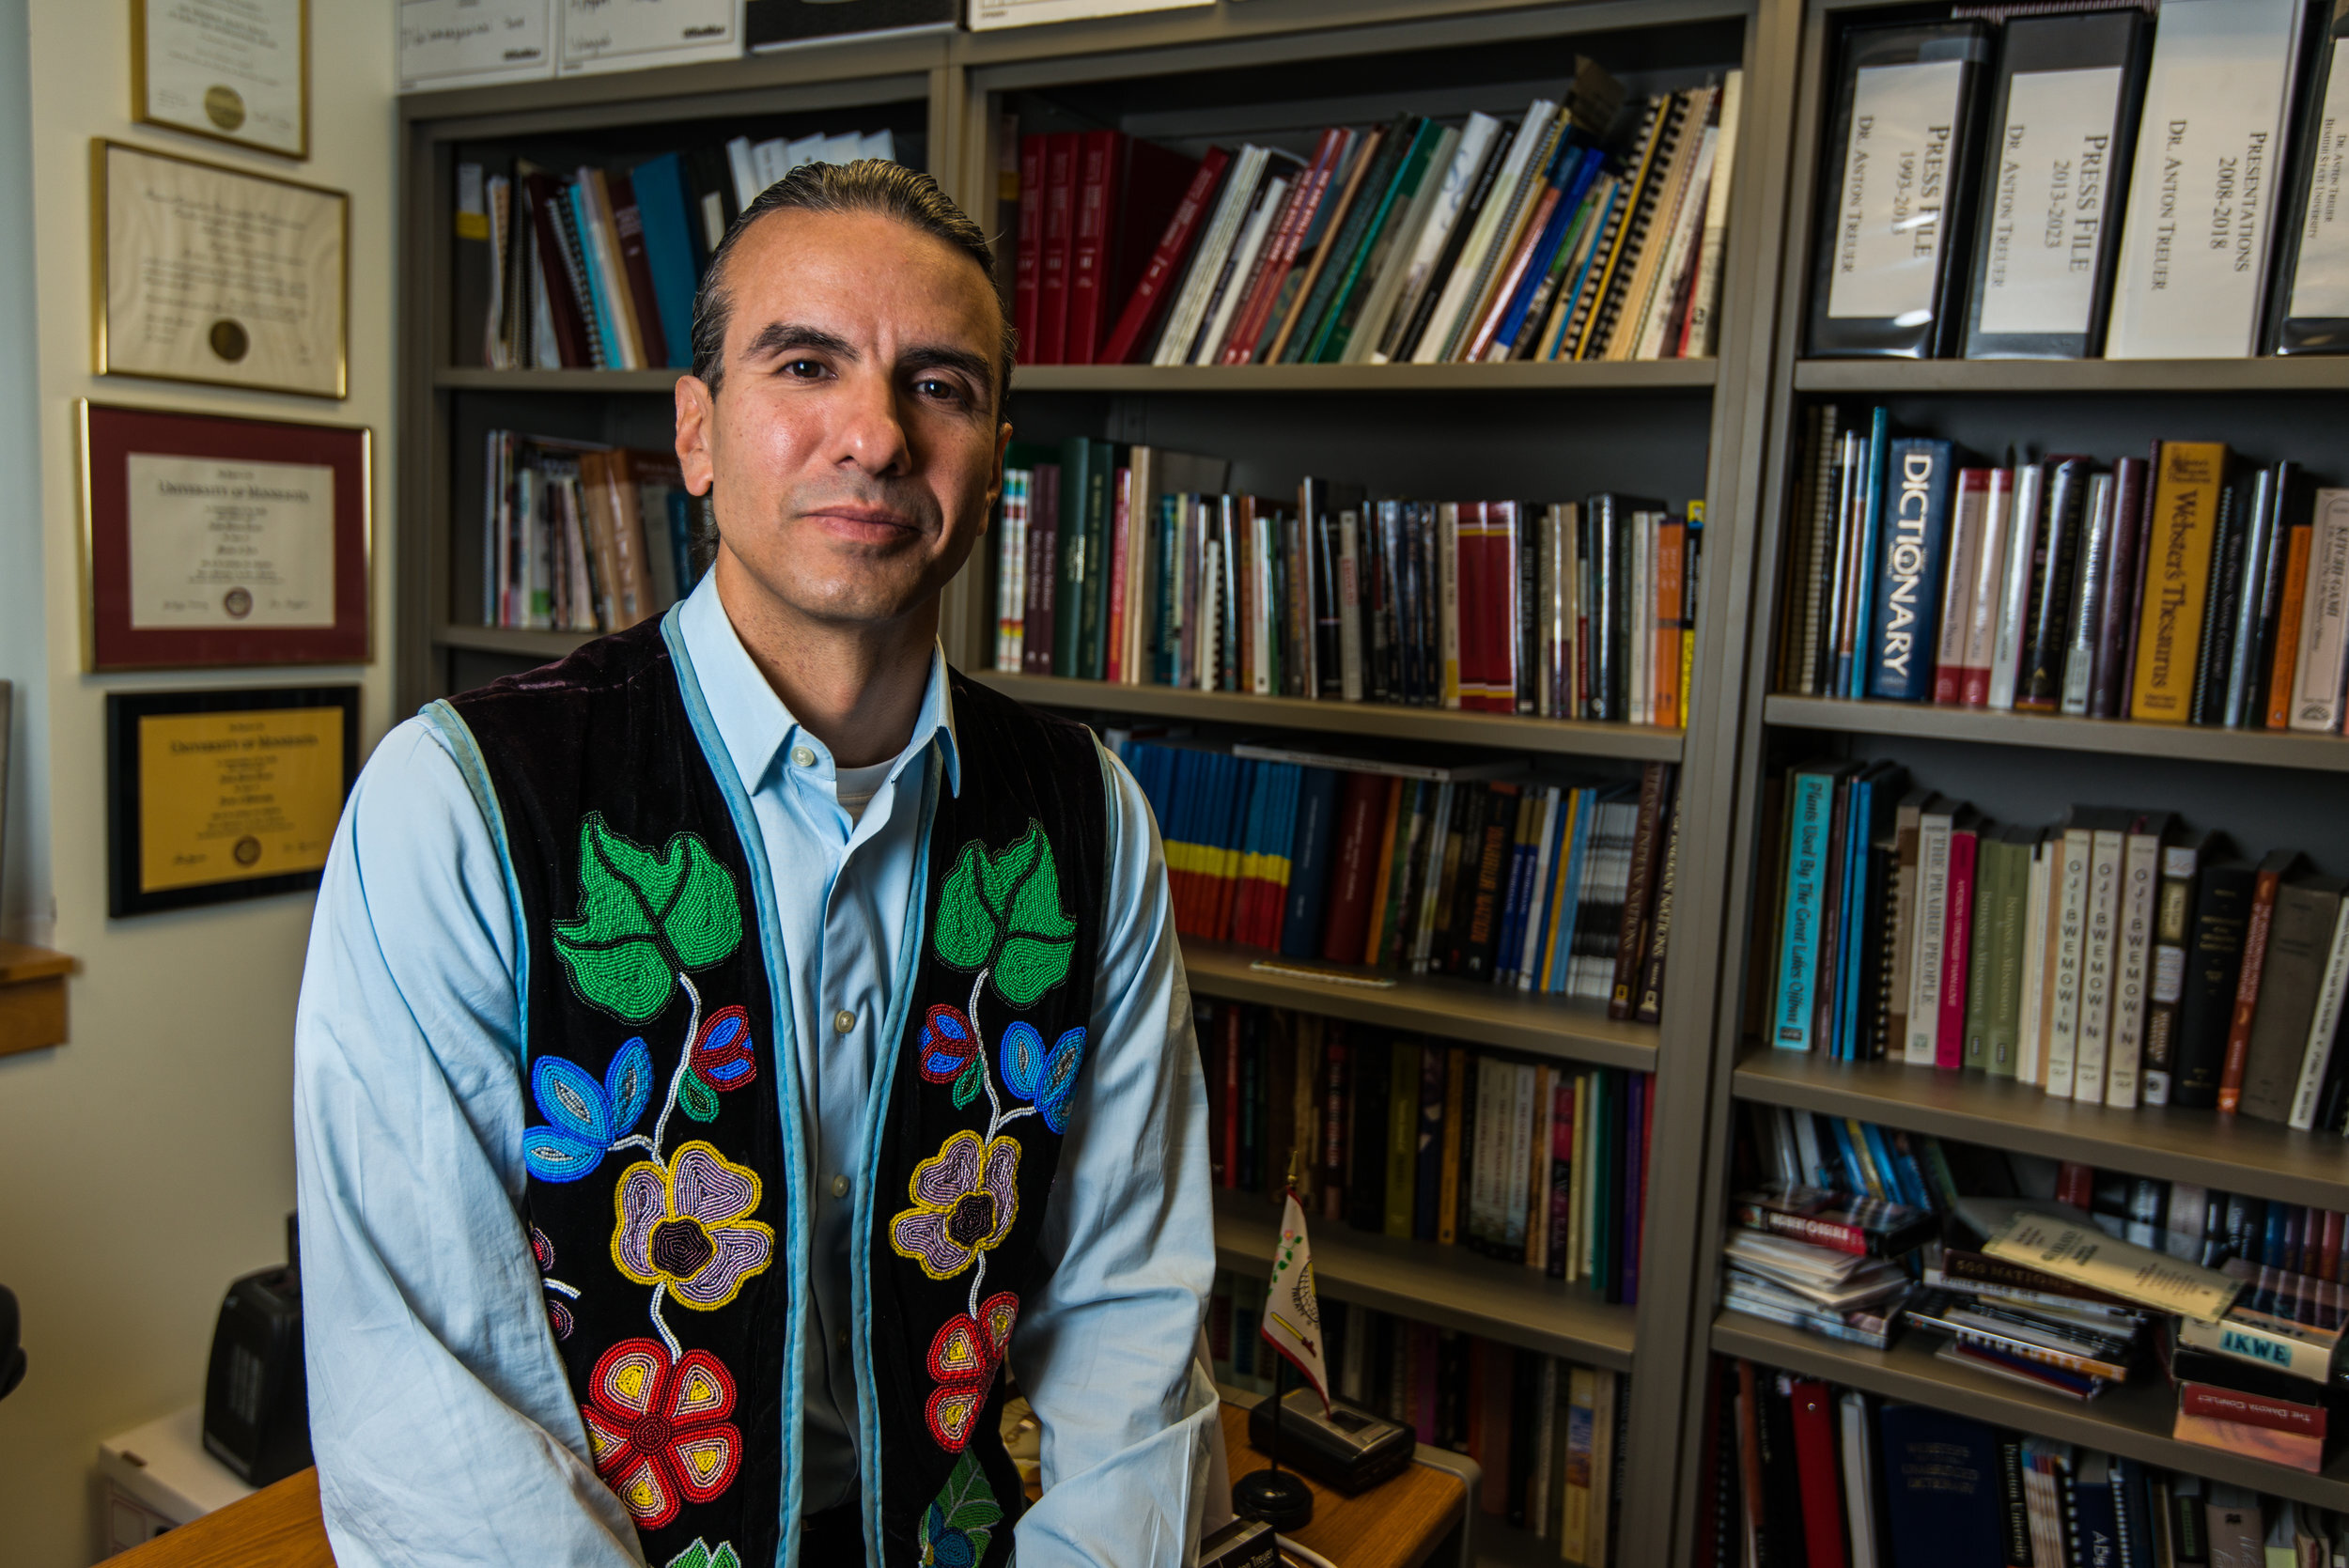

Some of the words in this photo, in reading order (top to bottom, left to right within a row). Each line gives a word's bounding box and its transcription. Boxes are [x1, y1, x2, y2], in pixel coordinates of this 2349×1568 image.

[1857, 116, 1875, 145] DR.
[2006, 124, 2025, 155] DR.
[2166, 119, 2187, 150] DR.
[1849, 149, 1870, 207] ANTON
[1921, 126, 1951, 198] PRESS
[1999, 162, 2021, 219] ANTON
[2077, 133, 2109, 210] PRESS
[2159, 157, 2183, 219] ANTON
[2045, 160, 2072, 249] 2013-2023
[2210, 157, 2237, 249] 2008-2018
[2234, 132, 2268, 272] PRESENTATIONS
[1841, 211, 1862, 274] TREUER
[1990, 224, 2014, 288] TREUER
[2069, 217, 2099, 272] FILE
[2151, 224, 2176, 291] TREUER
[2163, 489, 2199, 582] Webster's
[1882, 454, 1934, 677] DICTIONARY
[2150, 582, 2186, 689] Thesaurus
[1804, 781, 1823, 823] Plants
[1797, 860, 1815, 878] By
[1801, 823, 1819, 862] Used
[1931, 834, 1948, 868] THE
[1797, 880, 1814, 908] The
[1925, 874, 1945, 937] PRAIRIE
[1793, 911, 1812, 949] Great
[2056, 859, 2082, 1035] OJIBWEMOWIN
[2086, 862, 2111, 1039] OJIBWEMOWIN
[2121, 867, 2148, 1046] OJIBWEMOWIN
[1788, 950, 1808, 985] Lakes
[1921, 942, 1939, 1007] PEOPLE
[1955, 1258, 1987, 1274] 500
[2223, 1330, 2288, 1364] IKWE
[2197, 1394, 2246, 1409] CONFLICT
[2248, 1403, 2288, 1419] DAKOTA
[2290, 1410, 2311, 1421] THE
